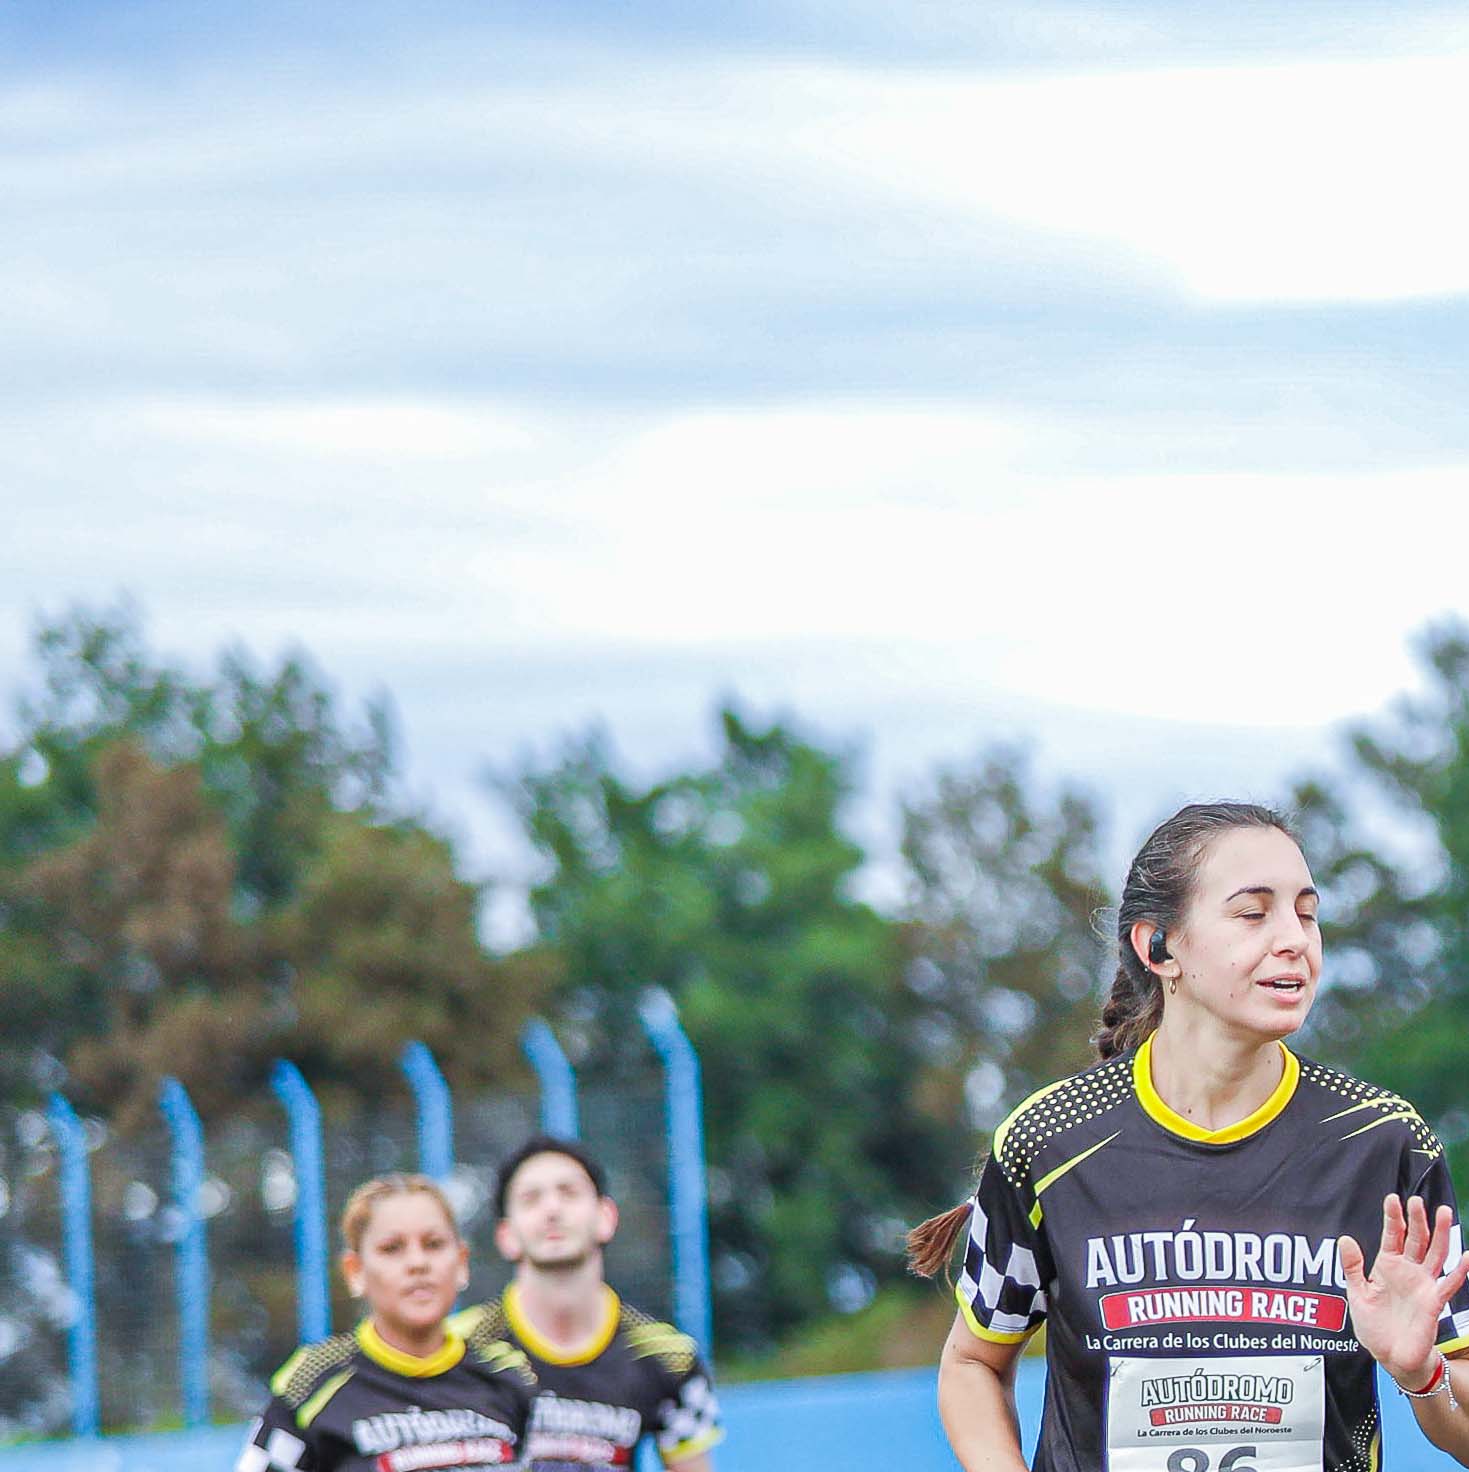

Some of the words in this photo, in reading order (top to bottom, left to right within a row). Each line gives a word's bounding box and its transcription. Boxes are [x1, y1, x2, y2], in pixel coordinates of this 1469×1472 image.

[1127, 1290, 1244, 1324] RUNNING
[1251, 1292, 1319, 1325] RACE
[1086, 1334, 1101, 1350] La
[1103, 1335, 1158, 1351] Carrera
[1163, 1332, 1183, 1349] de
[1187, 1332, 1210, 1349] los
[1213, 1332, 1267, 1350] Clubes
[1271, 1333, 1296, 1350] del
[1300, 1334, 1359, 1352] Noroeste
[1141, 1367, 1294, 1407] AUTÓDROMO
[1164, 1405, 1227, 1424] RUNNING
[1231, 1405, 1268, 1422] RACE
[1137, 1429, 1147, 1437] La
[1149, 1429, 1181, 1437] Carrera
[1182, 1428, 1194, 1436] de
[1195, 1428, 1208, 1436] los
[1209, 1427, 1238, 1435] Clubes
[1239, 1427, 1253, 1435] del
[1254, 1427, 1293, 1435] Noroeste
